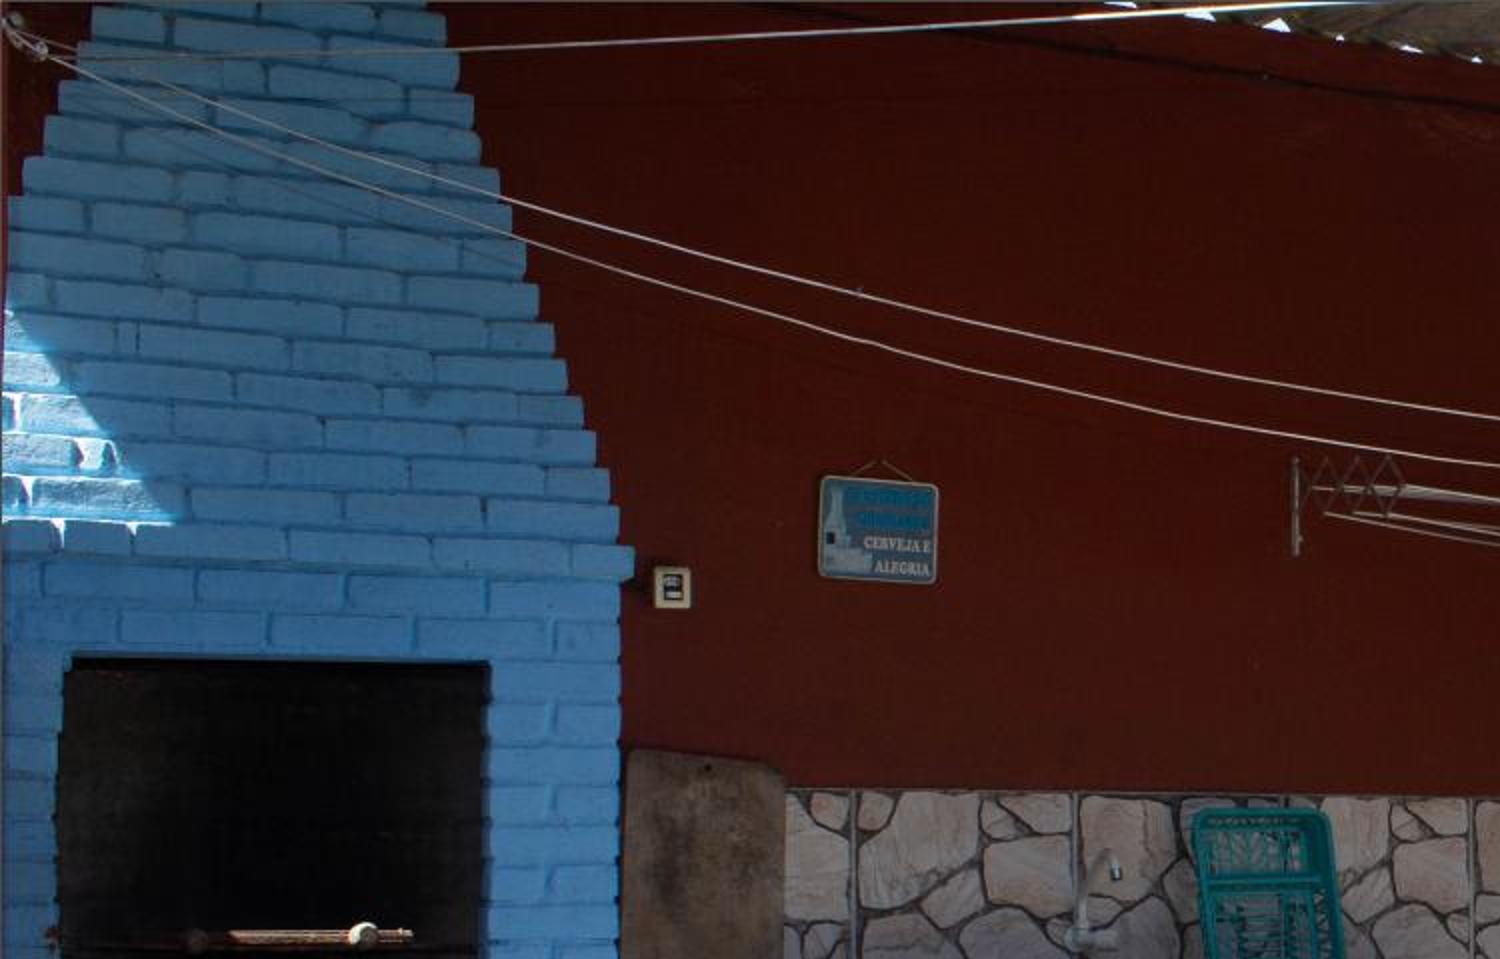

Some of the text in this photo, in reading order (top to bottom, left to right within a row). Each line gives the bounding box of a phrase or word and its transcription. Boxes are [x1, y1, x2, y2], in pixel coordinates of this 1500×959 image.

[863, 535, 931, 553] CERVEJA E
[874, 560, 930, 576] ALEGRIA
